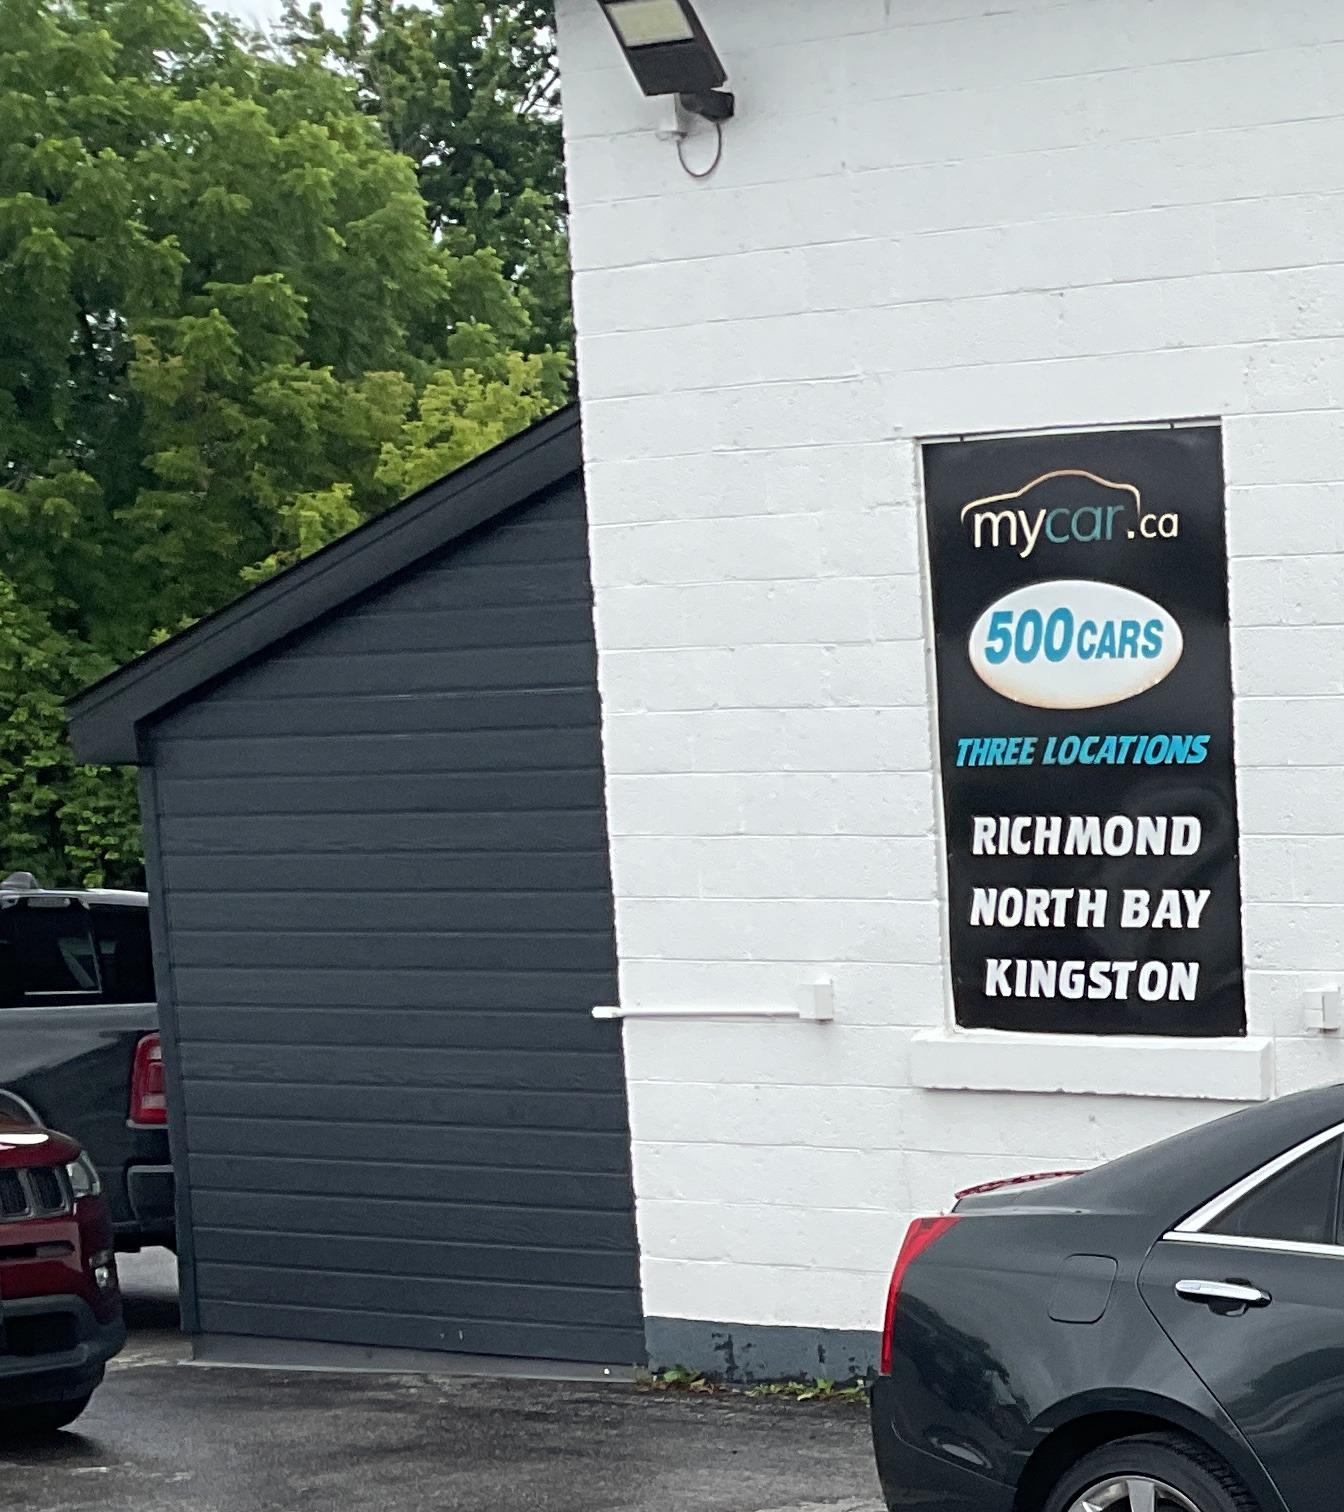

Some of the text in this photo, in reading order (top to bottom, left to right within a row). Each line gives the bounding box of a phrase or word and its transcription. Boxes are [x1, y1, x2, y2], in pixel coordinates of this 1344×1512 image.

[974, 503, 1179, 558] mycar.ca
[984, 607, 1164, 663] 500 CARS
[956, 734, 1211, 767] THREE LOCATIONS
[972, 815, 1202, 857] RICHMOND
[969, 887, 1212, 929] NORTH BAY
[985, 959, 1200, 1002] KINGSTON
